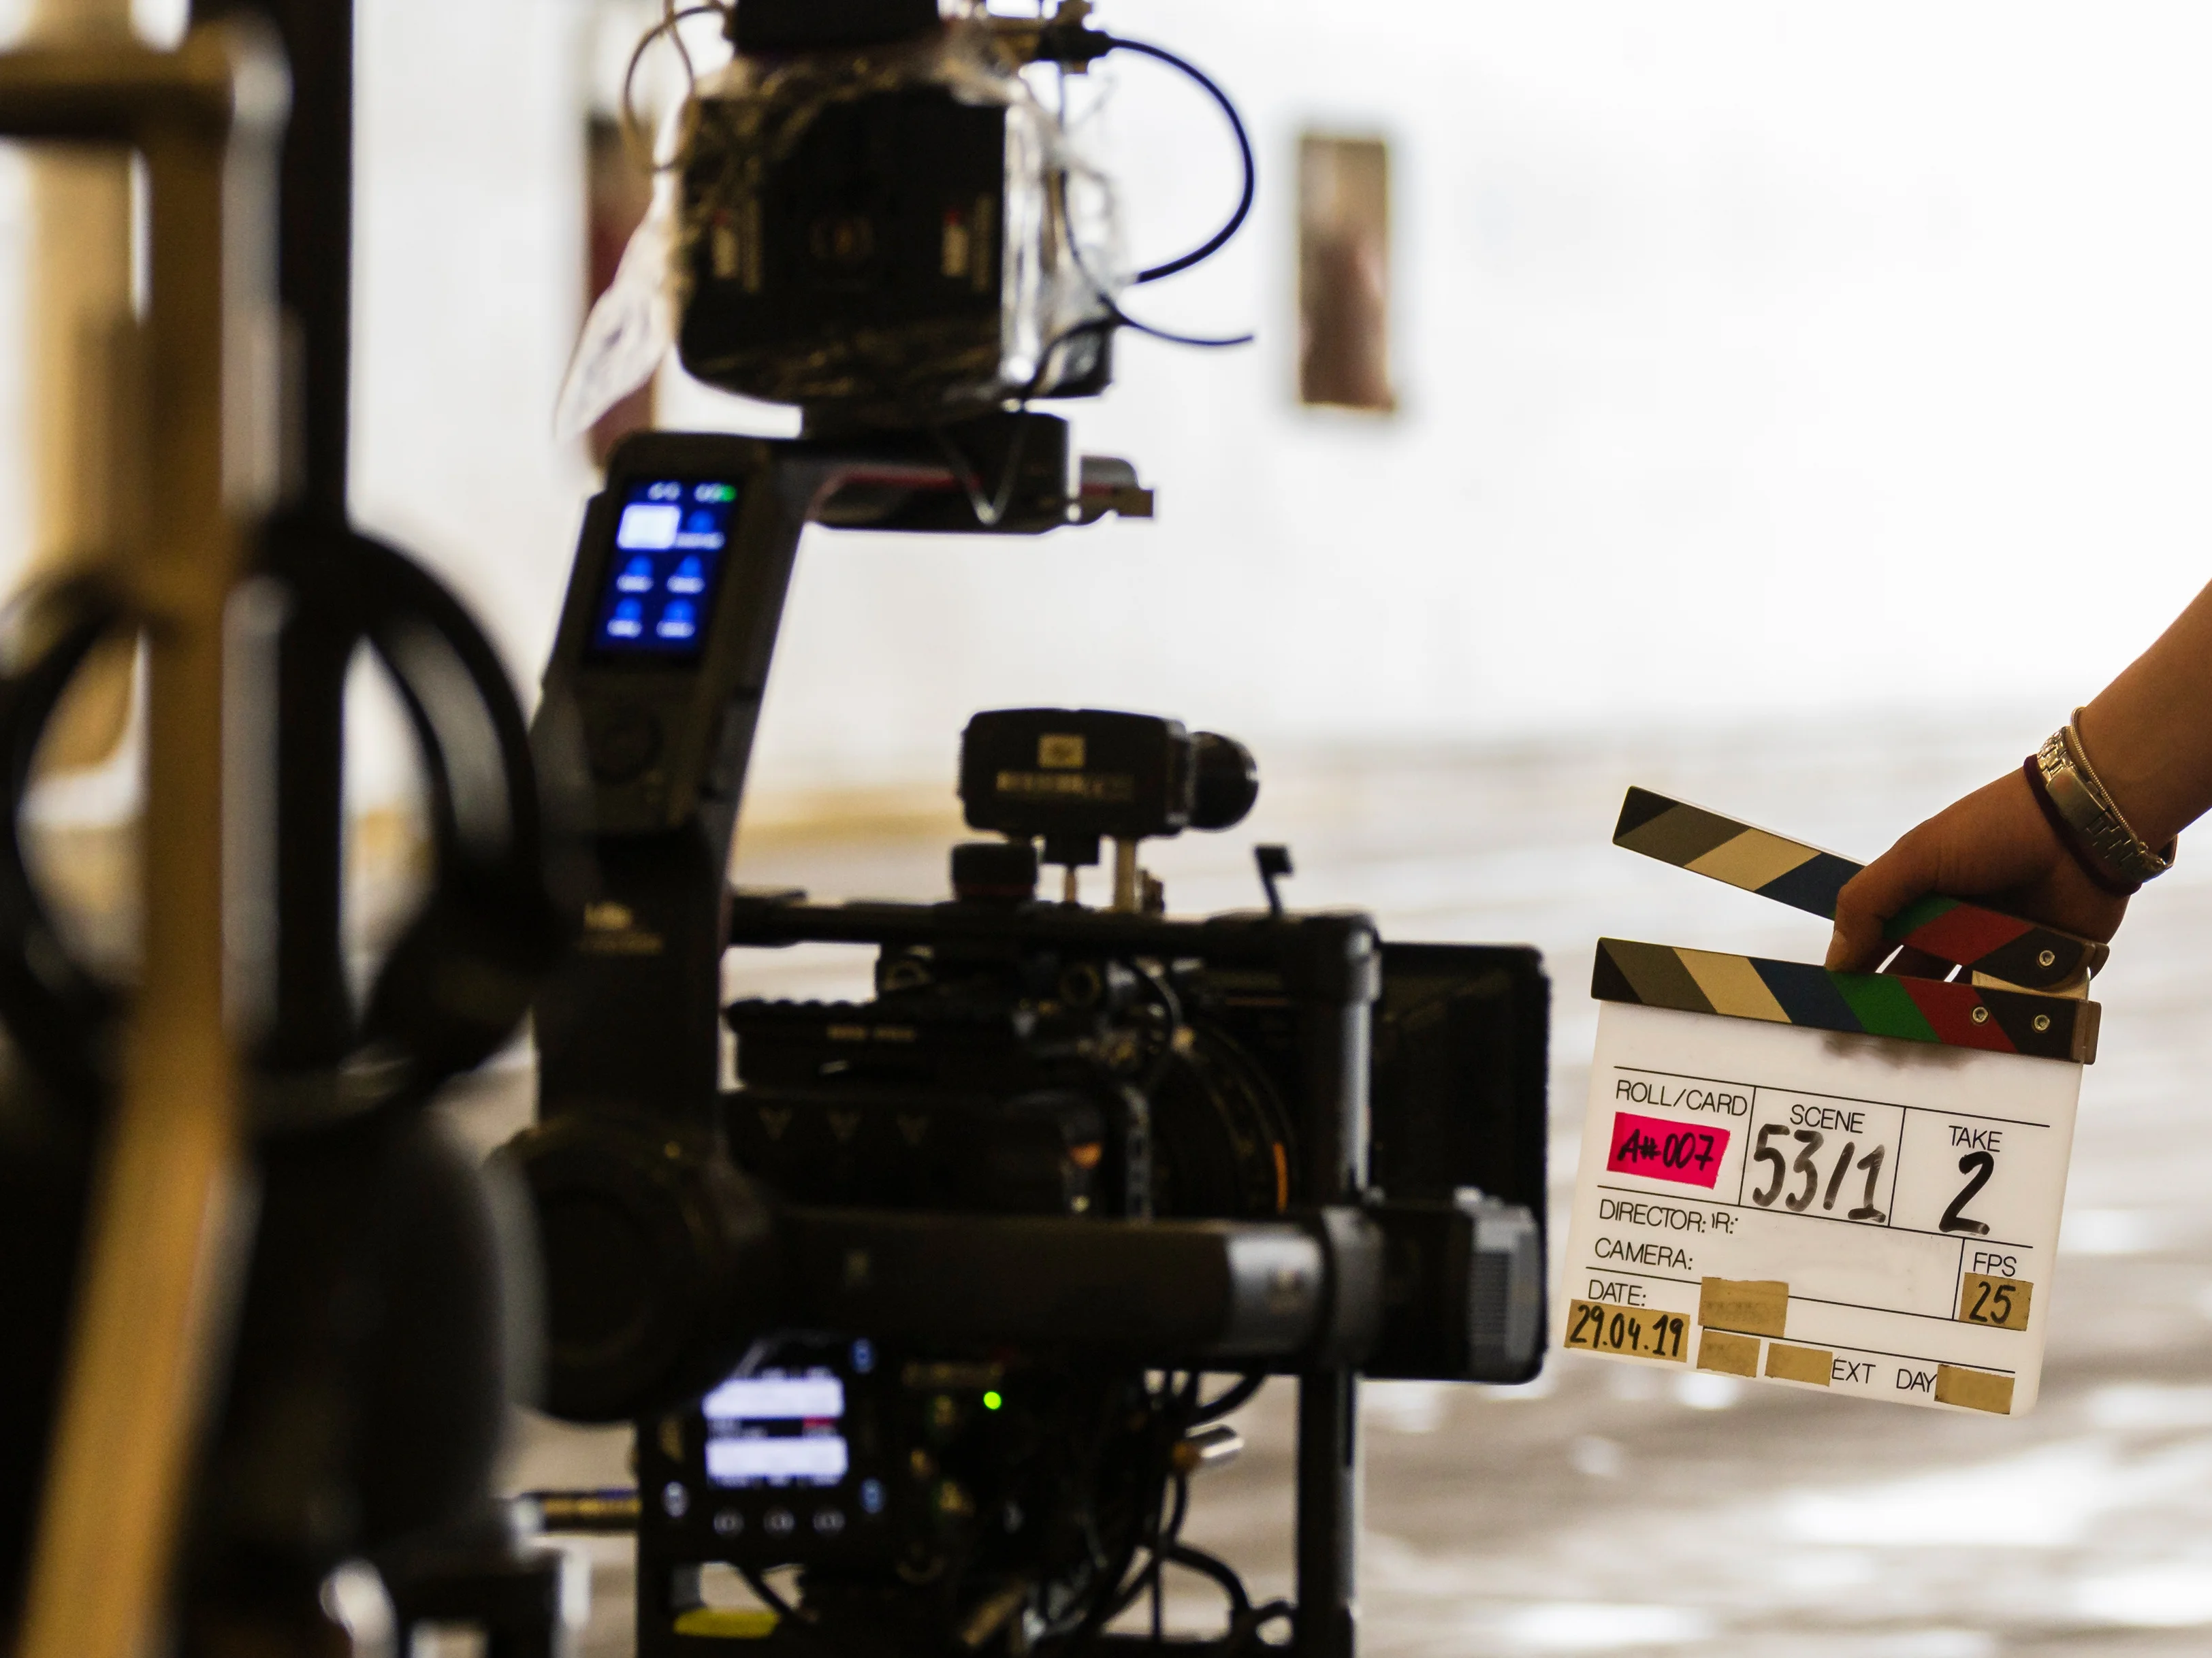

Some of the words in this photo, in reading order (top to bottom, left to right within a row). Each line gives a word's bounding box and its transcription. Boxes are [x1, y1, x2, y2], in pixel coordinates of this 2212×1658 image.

[1616, 1079, 1748, 1116] ROLL/CARD
[1790, 1104, 1865, 1134] SCENE
[1949, 1125, 2003, 1152] TAKE
[1752, 1123, 1887, 1224] 53/1
[1938, 1150, 1995, 1235] 2
[1599, 1199, 1707, 1233] DIRECTOR:
[1594, 1237, 1693, 1271] CAMERA:
[1973, 1252, 2017, 1277] FPS
[1588, 1279, 1646, 1307] DATE:
[1968, 1280, 2017, 1324] 25
[1569, 1304, 1684, 1357] 29.04.19
[1831, 1359, 1876, 1384] EXT
[1896, 1368, 1938, 1393] DAY
